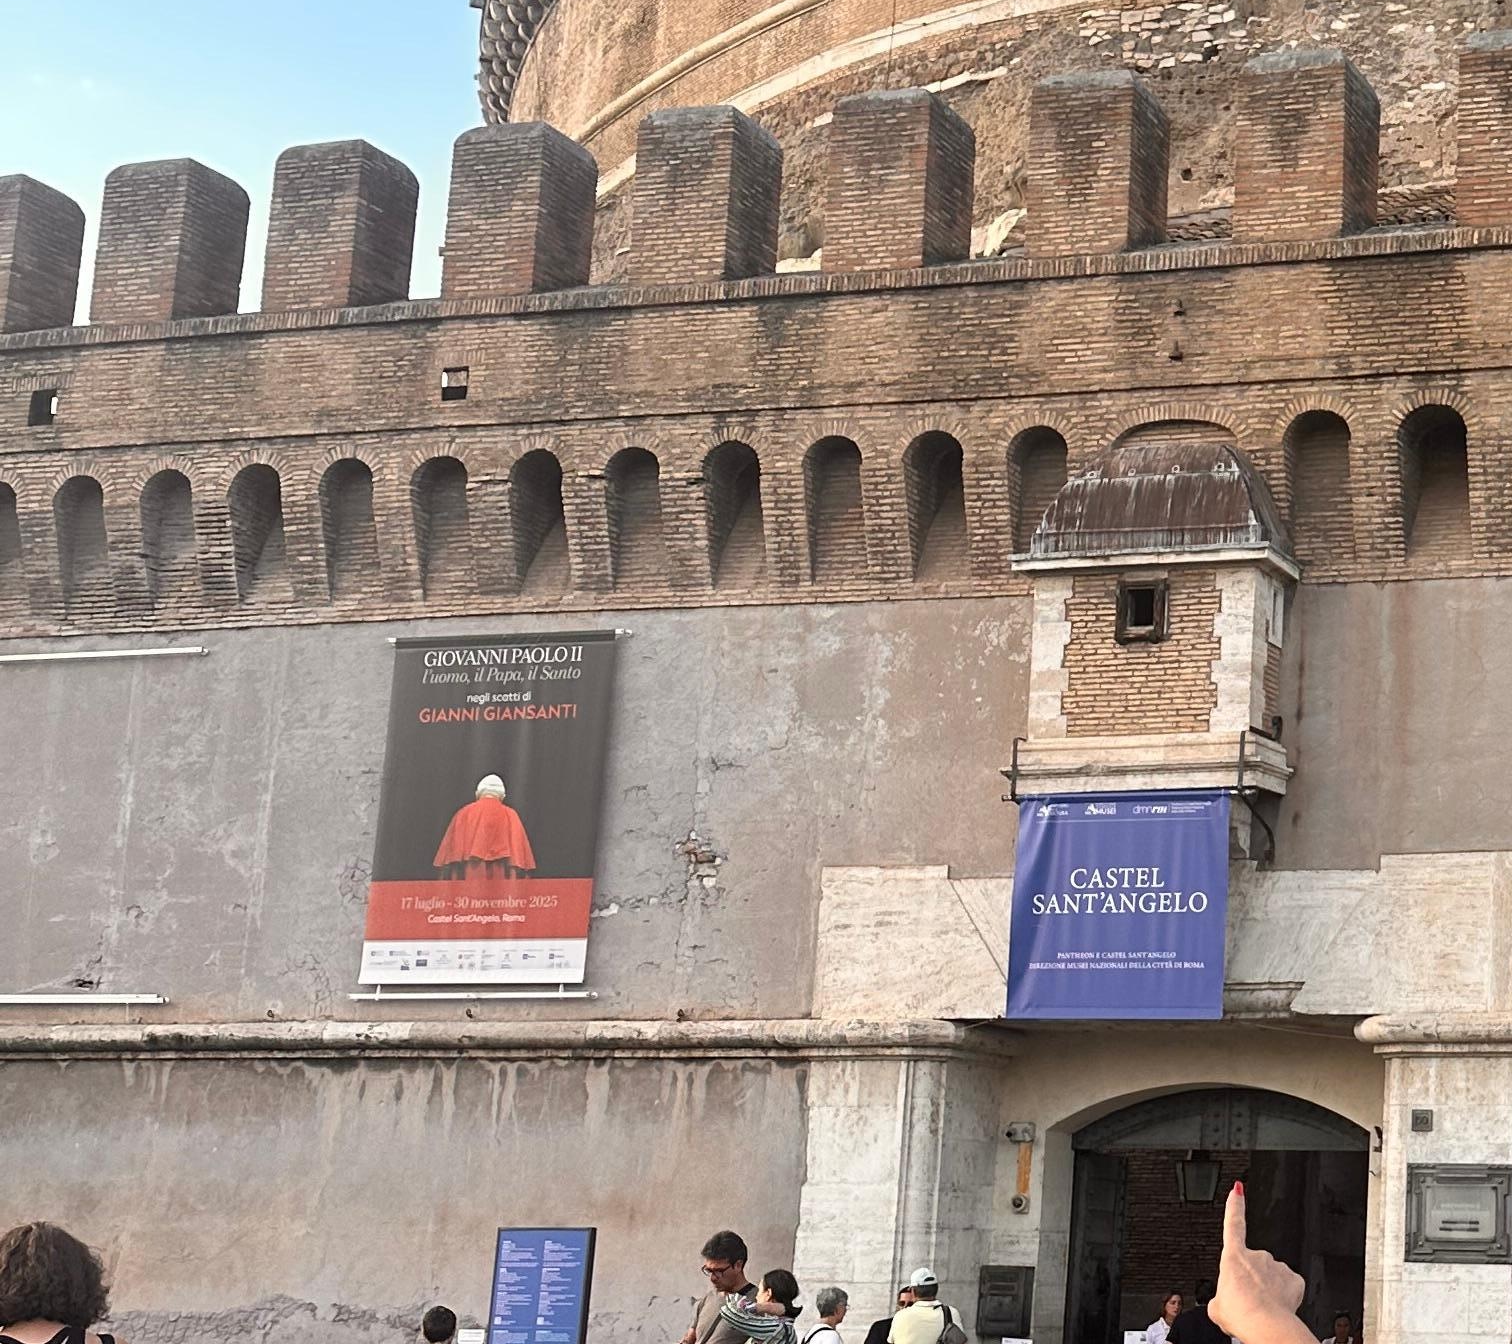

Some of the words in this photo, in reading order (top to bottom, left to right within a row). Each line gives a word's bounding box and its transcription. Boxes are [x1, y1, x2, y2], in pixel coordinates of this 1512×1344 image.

[424, 648, 508, 667] GIOVANNI
[511, 646, 568, 665] PAOLO
[571, 645, 583, 662] II
[474, 667, 482, 682] il
[486, 667, 525, 686] Papa,
[528, 665, 536, 681] il
[539, 665, 582, 681] Santo
[466, 692, 490, 705] negli
[491, 691, 521, 703] scatti
[522, 691, 532, 702] di
[418, 707, 479, 724] GIANNI
[483, 703, 577, 721] GIANSANTI
[1069, 867, 1165, 890] CASTEL
[401, 897, 412, 910] 17
[414, 896, 446, 913] luglio
[455, 896, 468, 909] 30
[470, 895, 527, 909] novembre
[528, 895, 558, 909] 2025
[1032, 891, 1208, 915] SANT'ANGELO
[1029, 962, 1066, 970] DIREZIONE
[1057, 952, 1094, 960] PANTHEON
